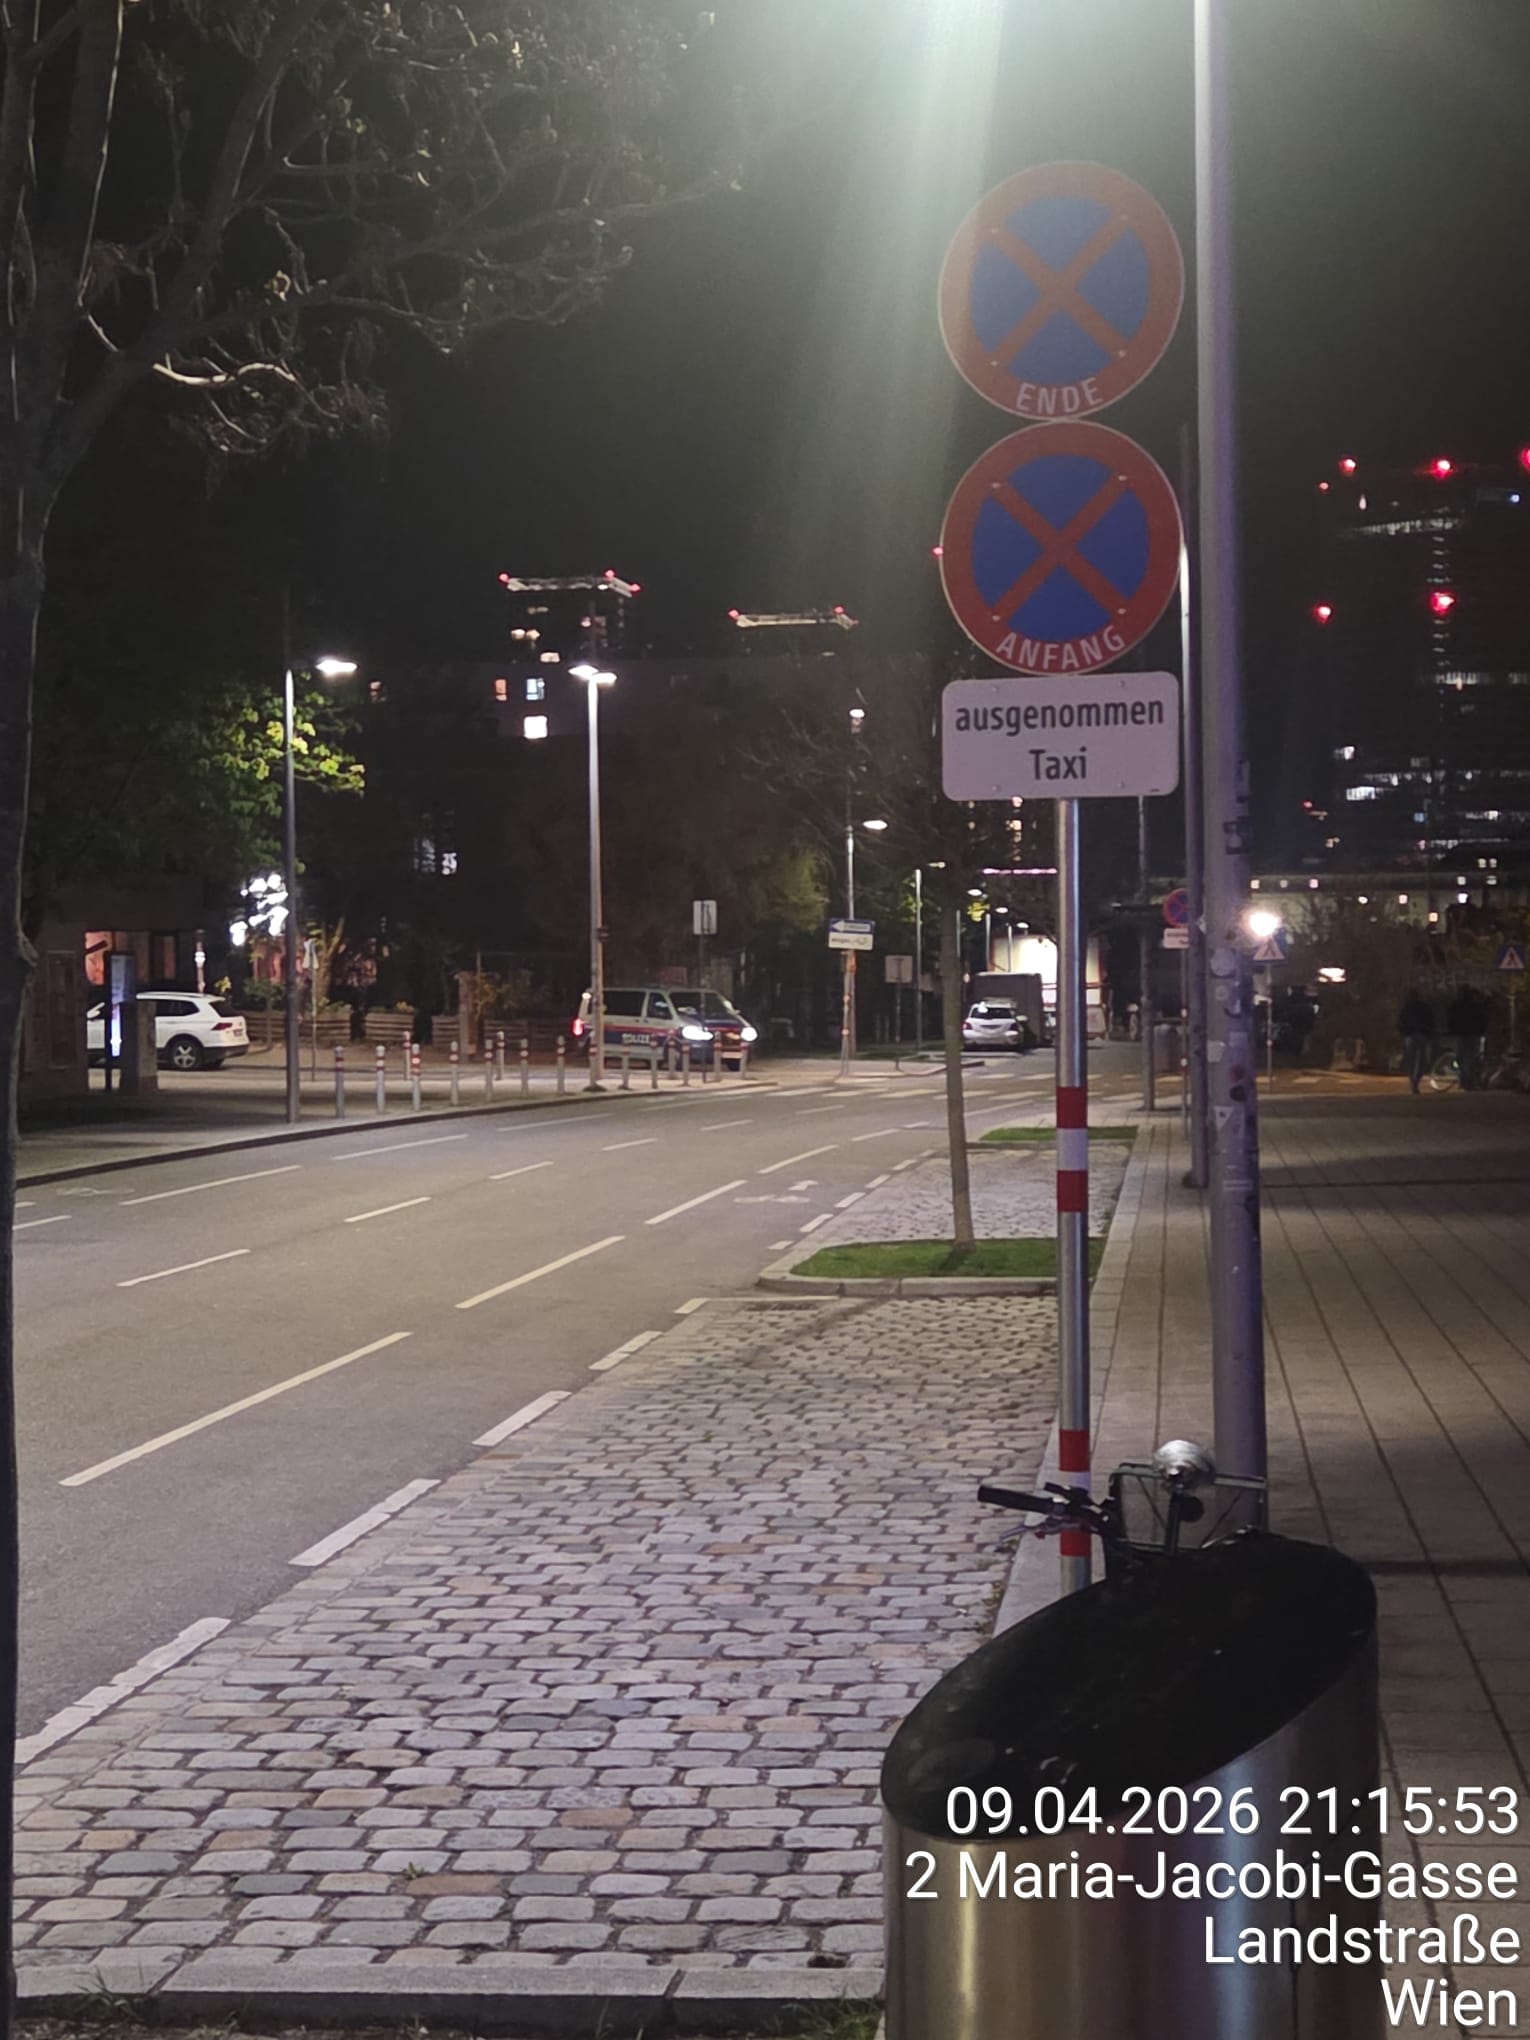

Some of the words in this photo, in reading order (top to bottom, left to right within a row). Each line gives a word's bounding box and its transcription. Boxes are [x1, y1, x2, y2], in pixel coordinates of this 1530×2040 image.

[1016, 377, 1103, 414] ENDE
[995, 625, 1125, 670] ANFANG
[955, 700, 1164, 737] ausgenommen
[1029, 746, 1087, 780] Taxi
